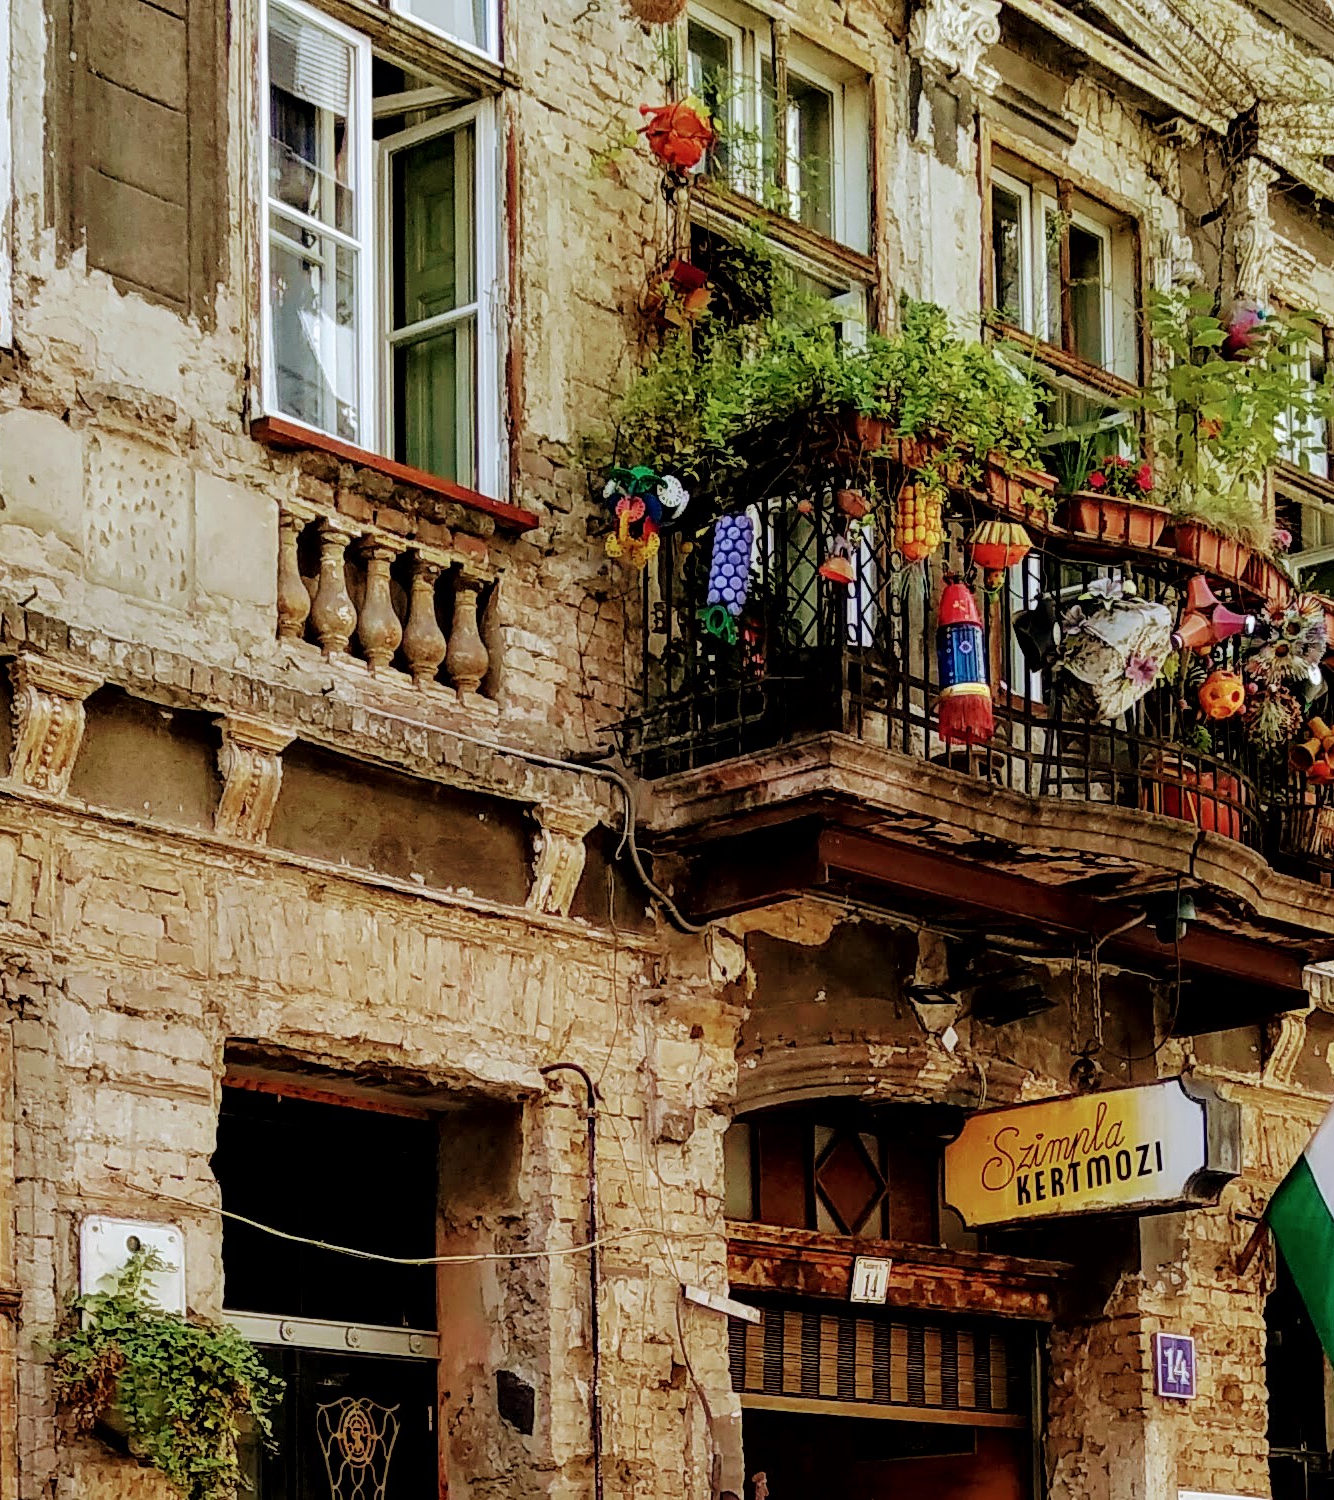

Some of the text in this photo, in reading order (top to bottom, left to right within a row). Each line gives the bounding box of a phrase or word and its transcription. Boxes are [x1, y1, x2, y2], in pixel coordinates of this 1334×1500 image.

[981, 1102, 1126, 1192] Szimpla
[1016, 1140, 1163, 1206] KERTMOZI
[863, 1272, 878, 1297] 14
[1164, 1346, 1190, 1386] 14
